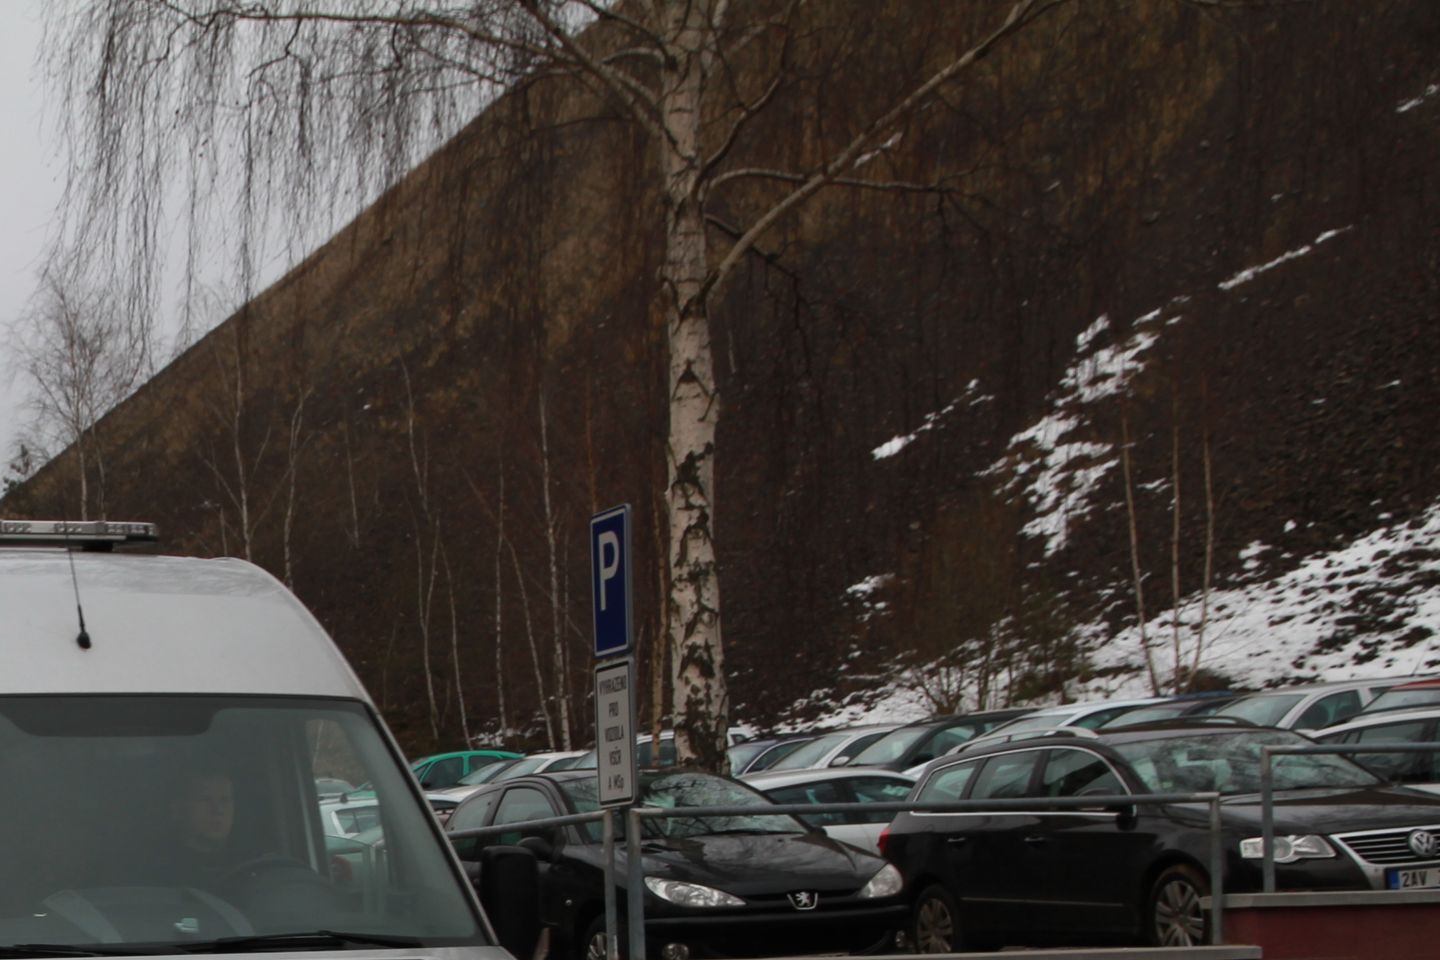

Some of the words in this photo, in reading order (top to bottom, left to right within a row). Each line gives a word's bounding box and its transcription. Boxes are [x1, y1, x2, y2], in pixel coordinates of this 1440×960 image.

[598, 530, 620, 612] P
[599, 674, 627, 696] VYHRAZENO
[608, 701, 619, 718] PRO
[1401, 871, 1427, 888] 2AV
